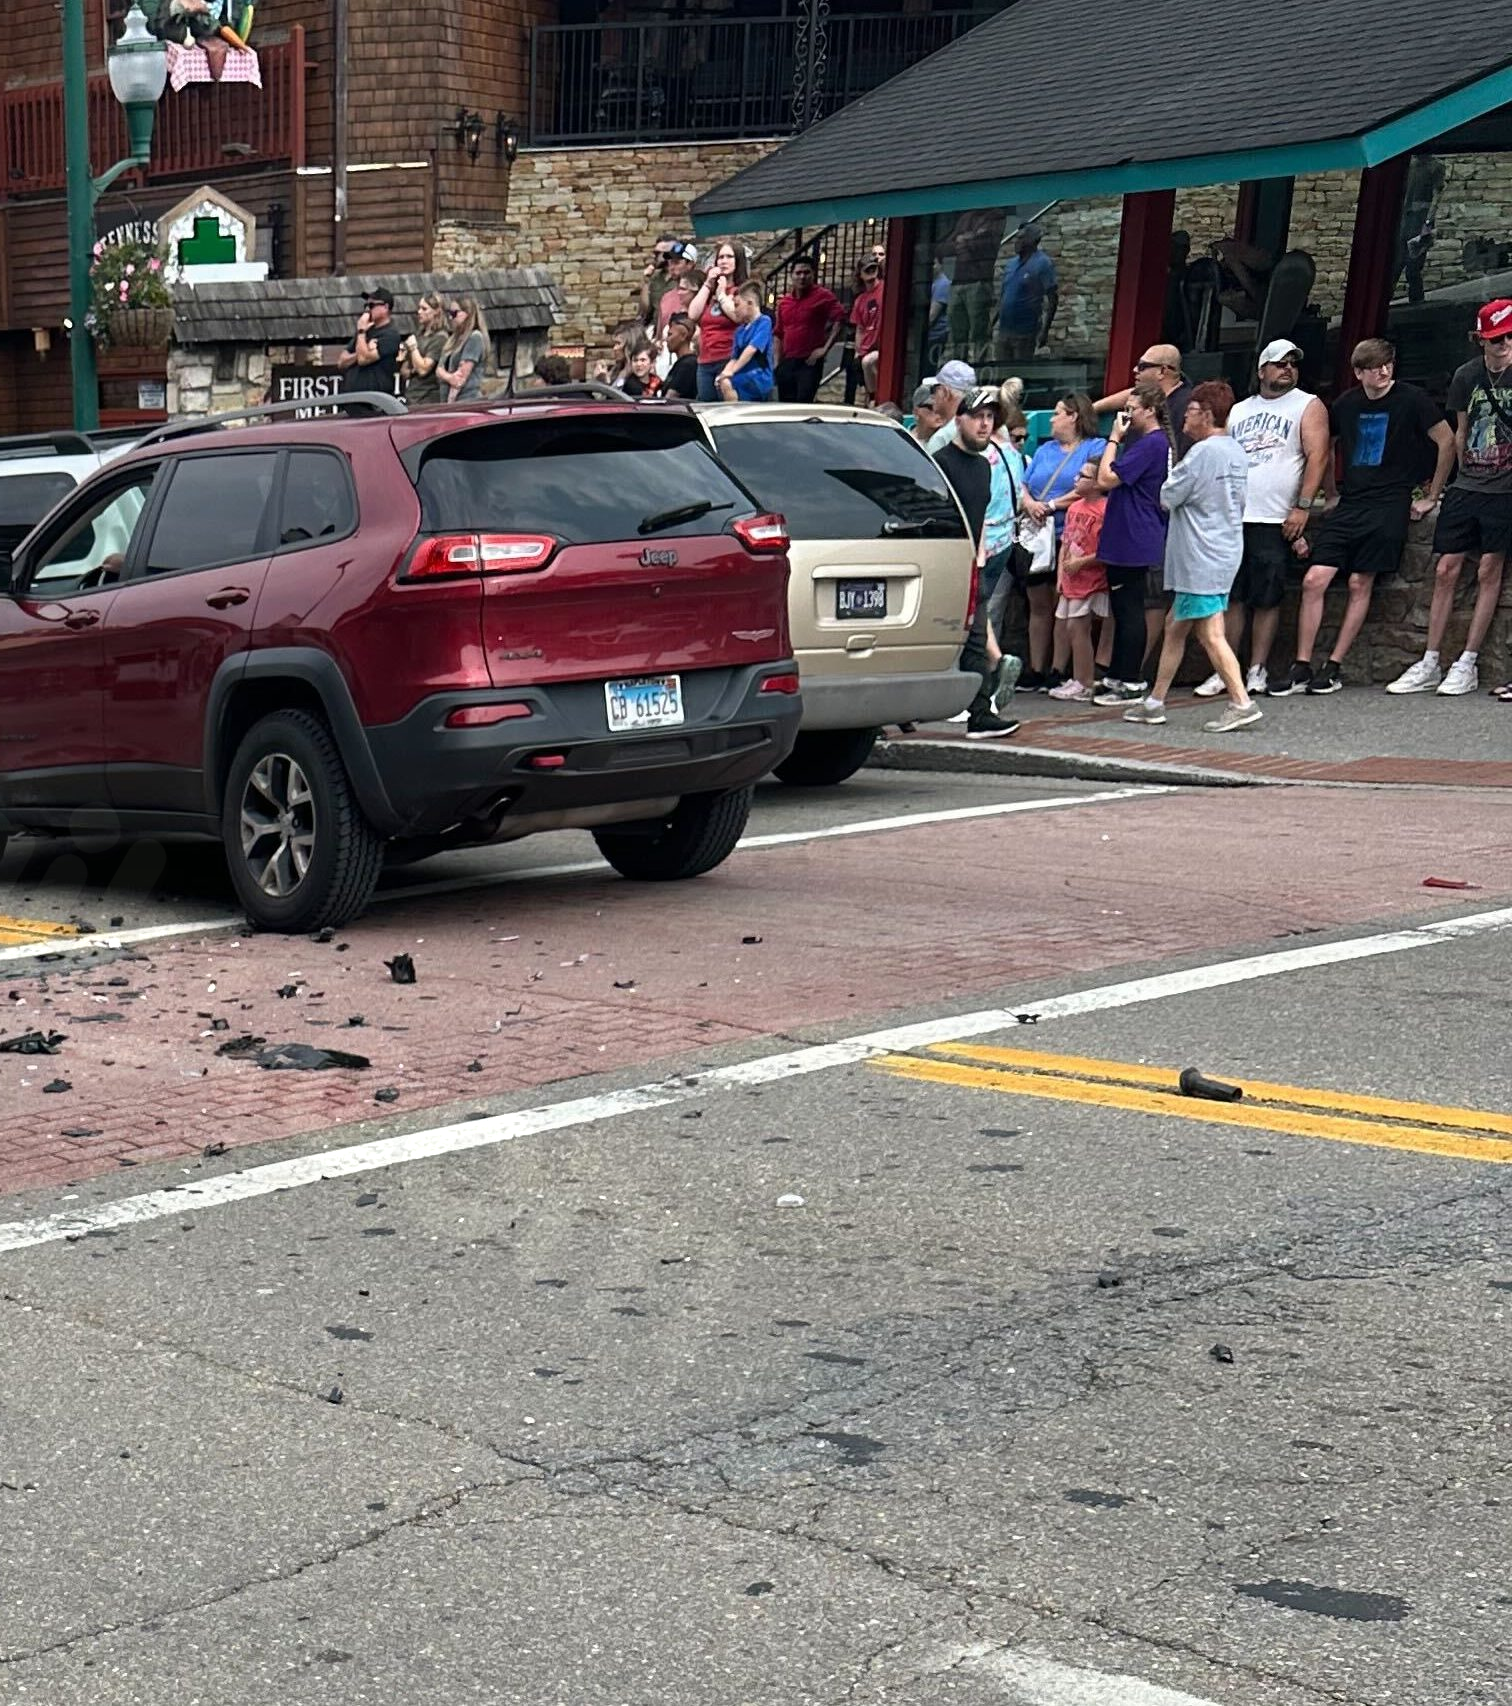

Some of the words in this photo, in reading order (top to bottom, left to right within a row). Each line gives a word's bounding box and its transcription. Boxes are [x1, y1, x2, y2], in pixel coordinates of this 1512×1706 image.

[99, 219, 160, 252] TENNESS
[279, 375, 343, 400] FIRST
[639, 549, 678, 567] Jeep
[610, 696, 627, 720] CB
[636, 690, 678, 718] 61525
